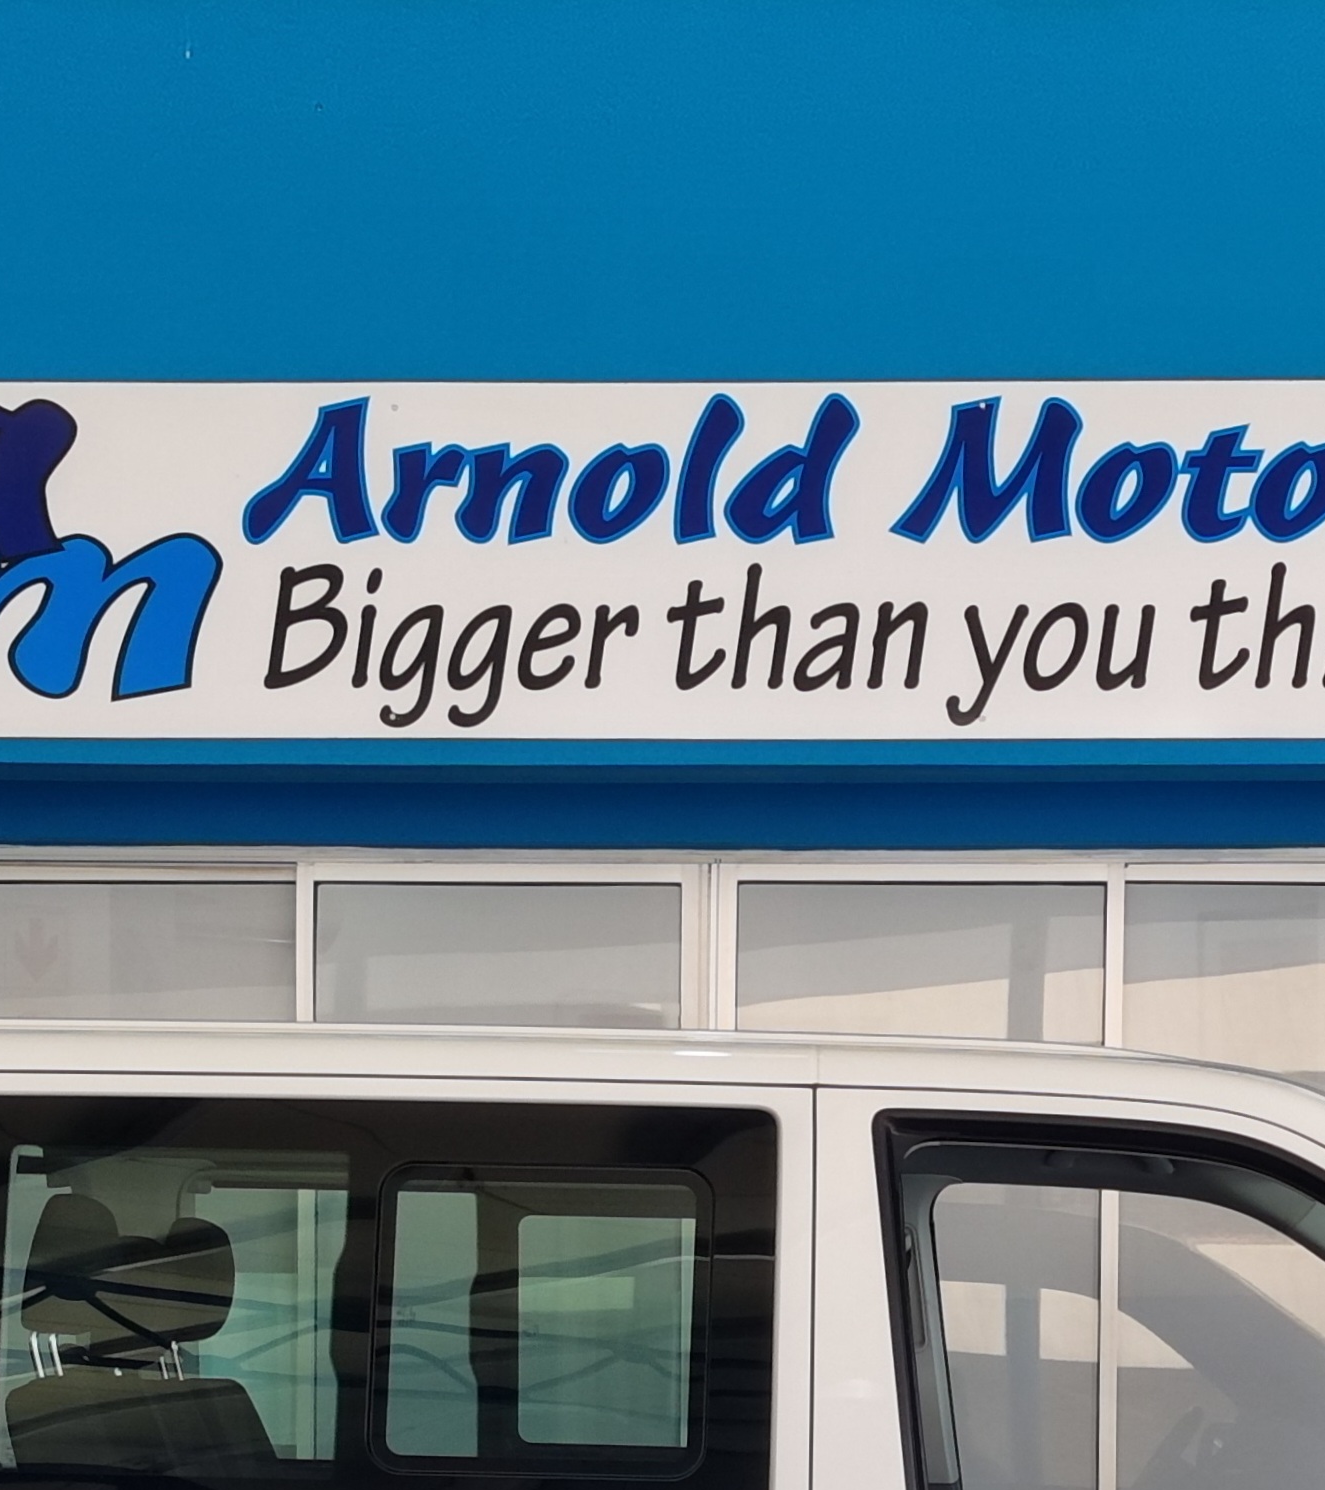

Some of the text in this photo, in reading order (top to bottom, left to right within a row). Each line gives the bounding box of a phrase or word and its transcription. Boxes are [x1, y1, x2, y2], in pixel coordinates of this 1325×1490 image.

[242, 393, 862, 546] Arnold
[263, 563, 640, 729] Bigger
[666, 562, 929, 693] than
[945, 602, 1156, 727] you
